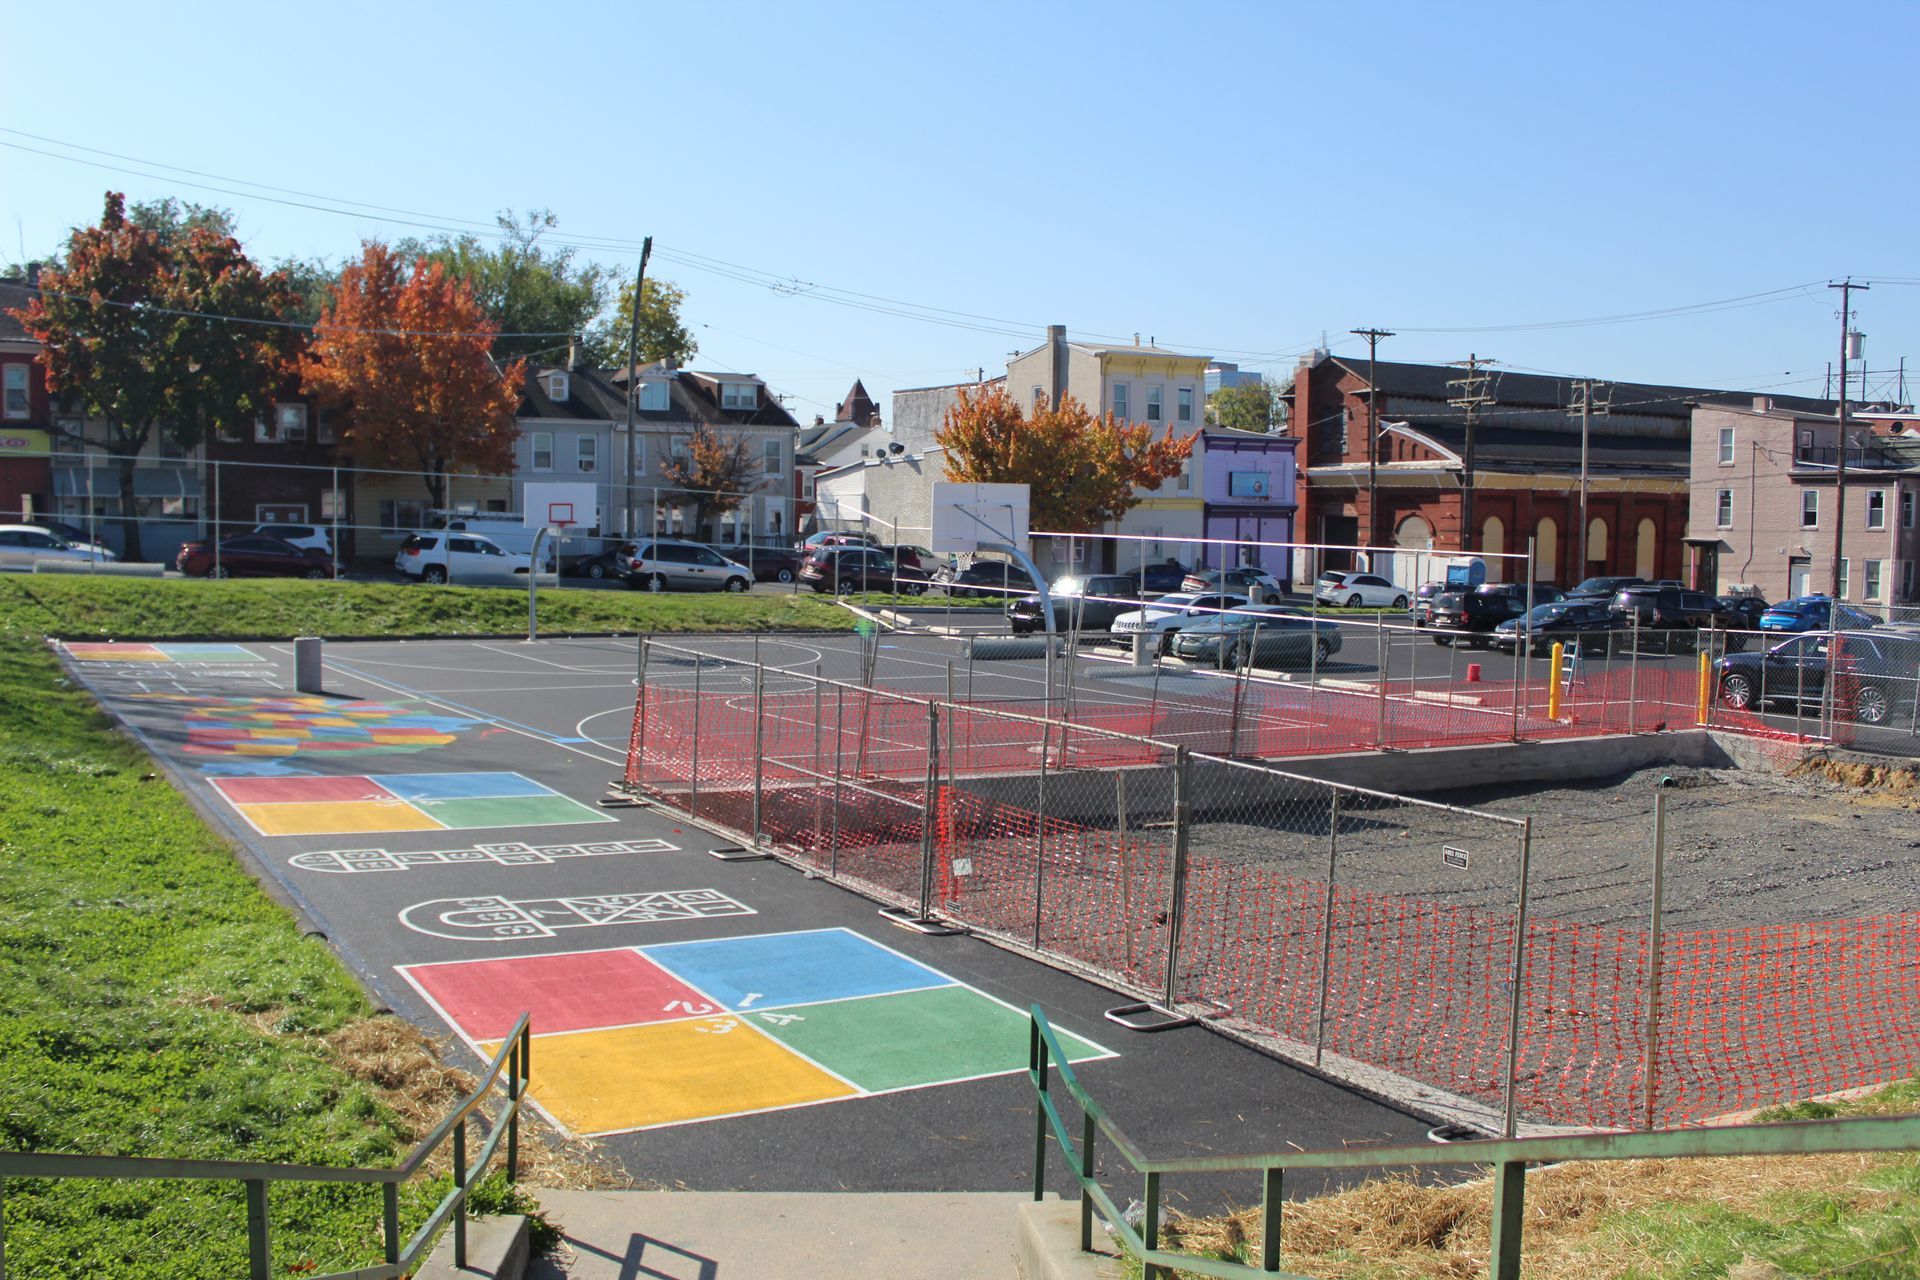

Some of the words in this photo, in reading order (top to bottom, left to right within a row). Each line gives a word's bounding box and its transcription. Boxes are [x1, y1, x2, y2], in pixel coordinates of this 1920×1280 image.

[486, 845, 522, 853] 5
[541, 847, 577, 855] 3
[588, 844, 624, 853] 2
[502, 854, 536, 862] 4
[355, 861, 393, 869] 8
[677, 892, 719, 901] 2
[457, 899, 505, 911] 10
[640, 901, 679, 911] 3
[476, 912, 518, 921] 8
[529, 908, 573, 919] 7
[494, 924, 536, 935] 9
[737, 992, 764, 1008] 1
[661, 1000, 714, 1015] 2
[759, 1012, 806, 1026] 4
[695, 1018, 738, 1034] 3
